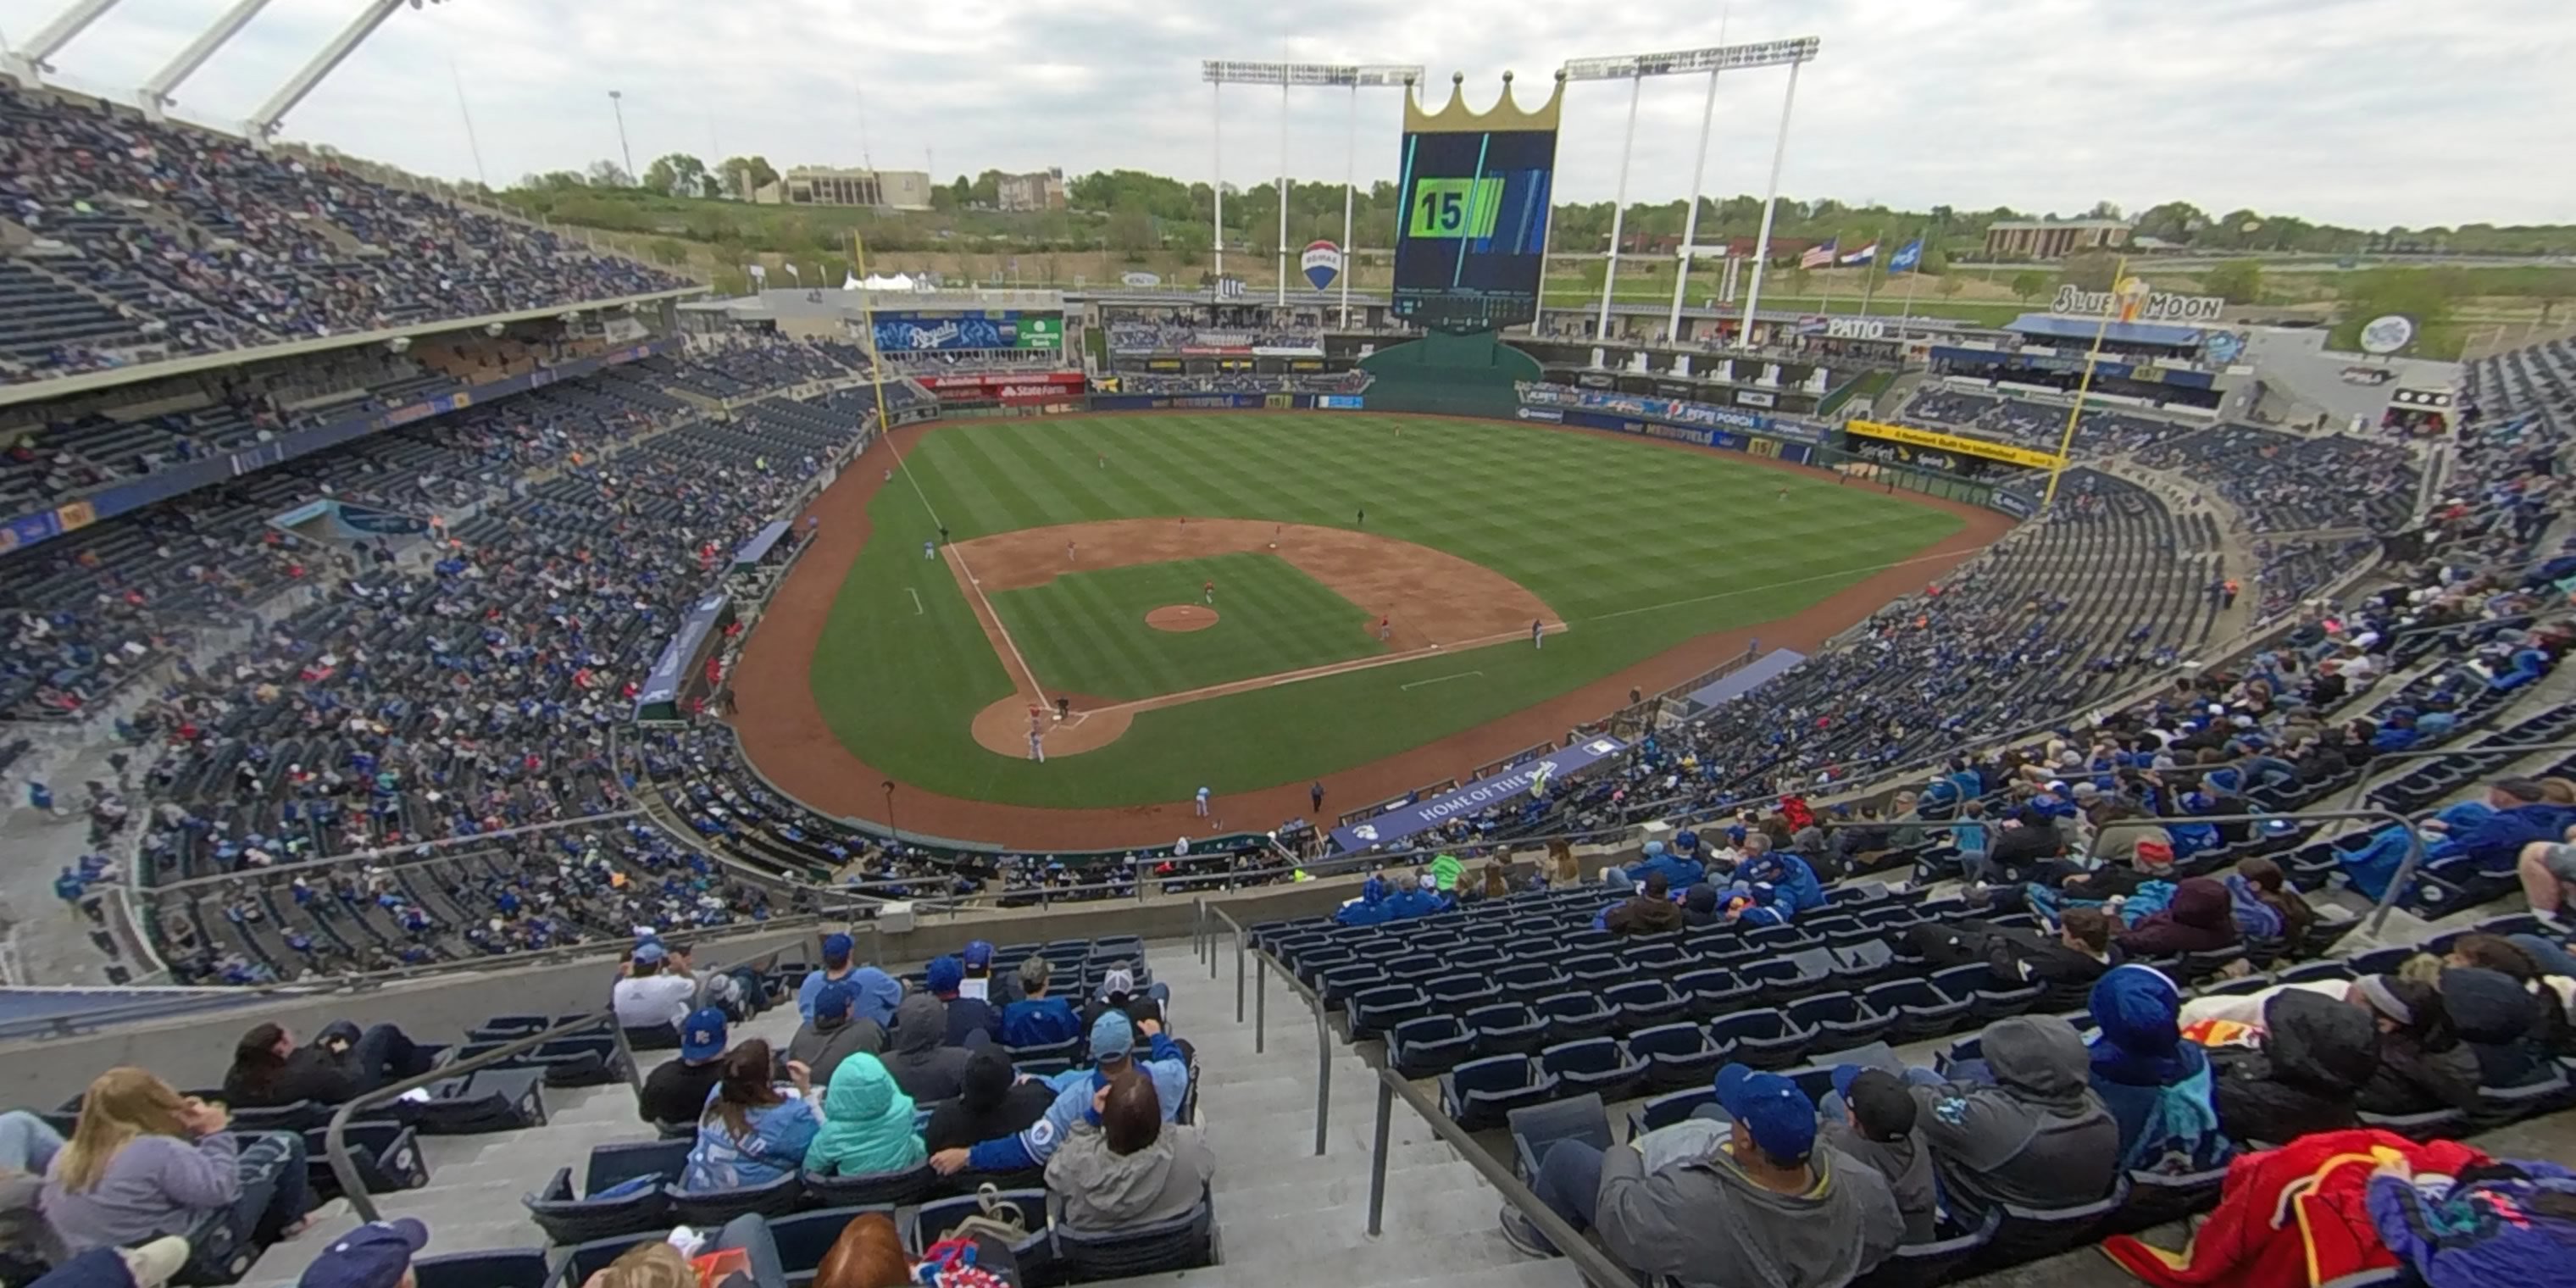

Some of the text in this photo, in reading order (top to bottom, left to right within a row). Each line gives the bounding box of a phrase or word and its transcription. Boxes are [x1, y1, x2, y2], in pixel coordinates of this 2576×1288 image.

[1421, 191, 1463, 231] 15
[2051, 284, 2223, 319] BLUE MOON
[910, 320, 958, 348] Royals
[1828, 318, 1884, 339] PATIO
[1017, 386, 1067, 396] State Farm
[1686, 408, 1754, 427] PEPSI PORCH
[1418, 774, 1529, 821] HOME OF THE
